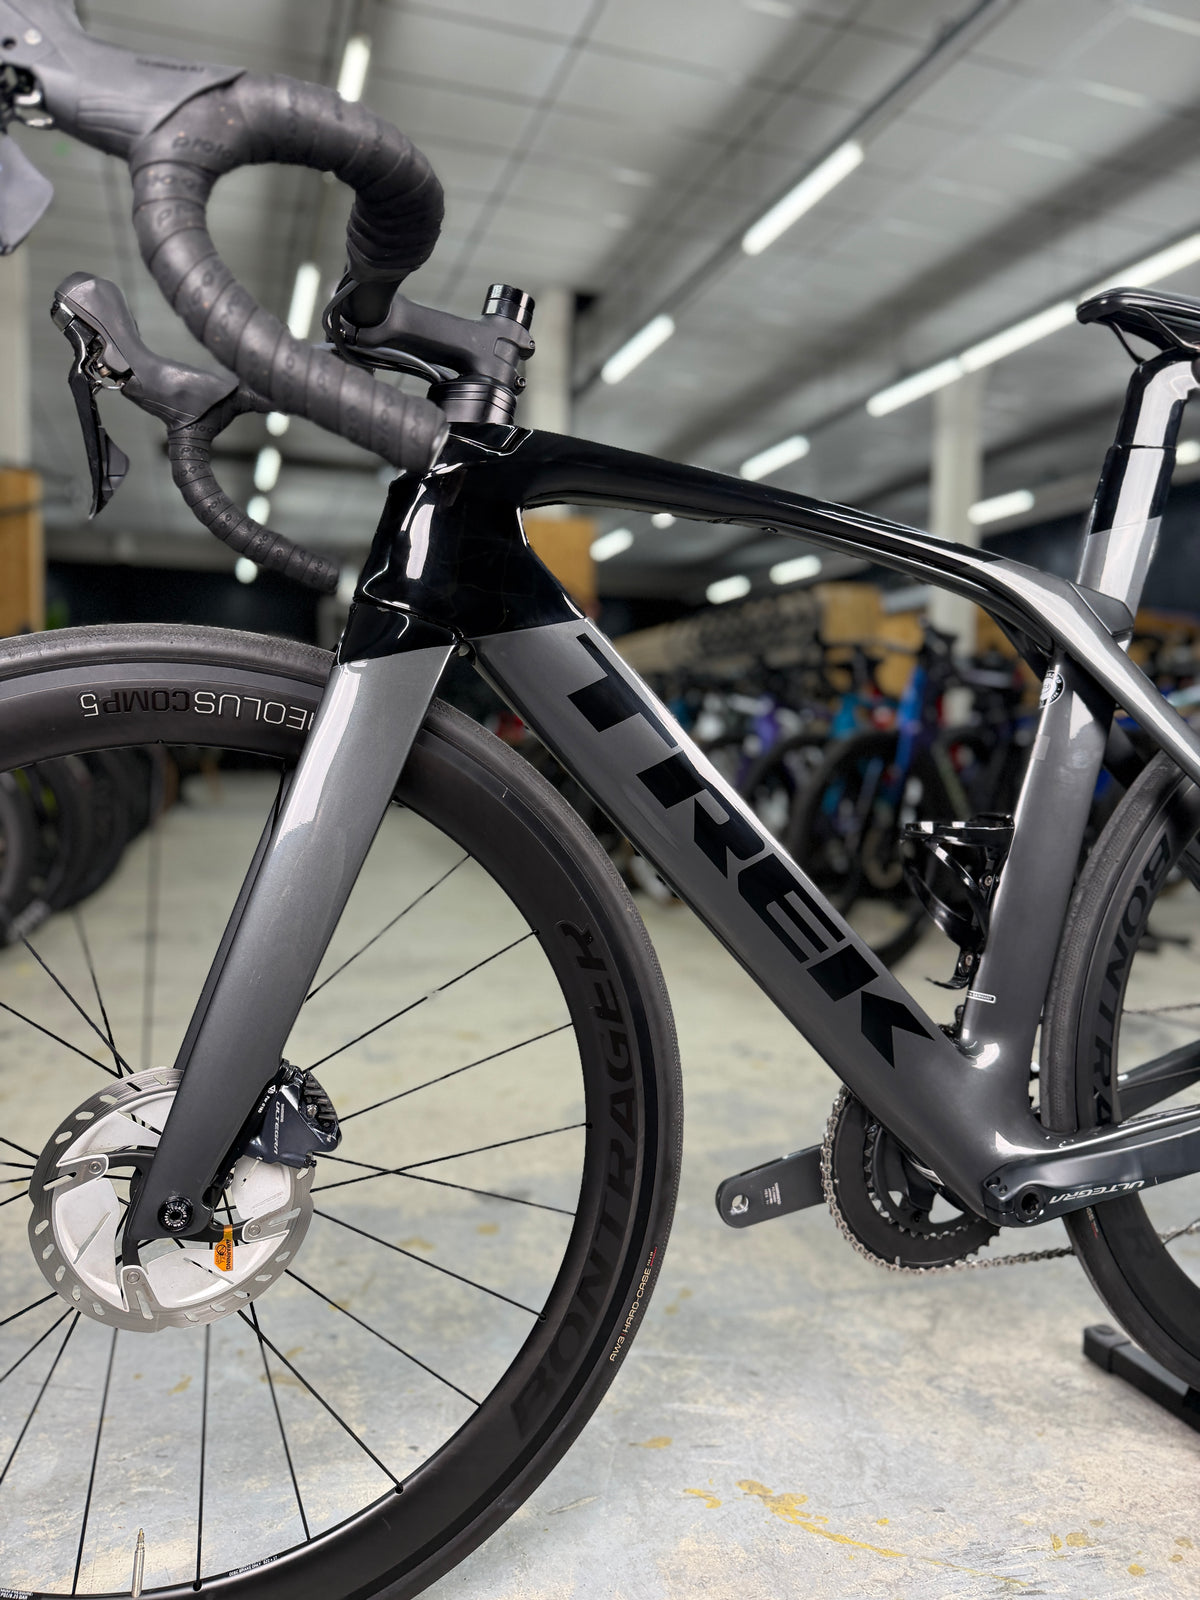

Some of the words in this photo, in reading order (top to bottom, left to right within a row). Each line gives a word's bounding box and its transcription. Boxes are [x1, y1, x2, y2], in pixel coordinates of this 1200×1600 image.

[194, 691, 316, 731] EOLUS
[567, 633, 935, 1069] TREK
[511, 920, 638, 1439] BONTRAGER
[1049, 1180, 1145, 1205] ULTEGRA
[609, 1335, 626, 1362] AW3
[622, 1267, 652, 1334] HARD-CASE
